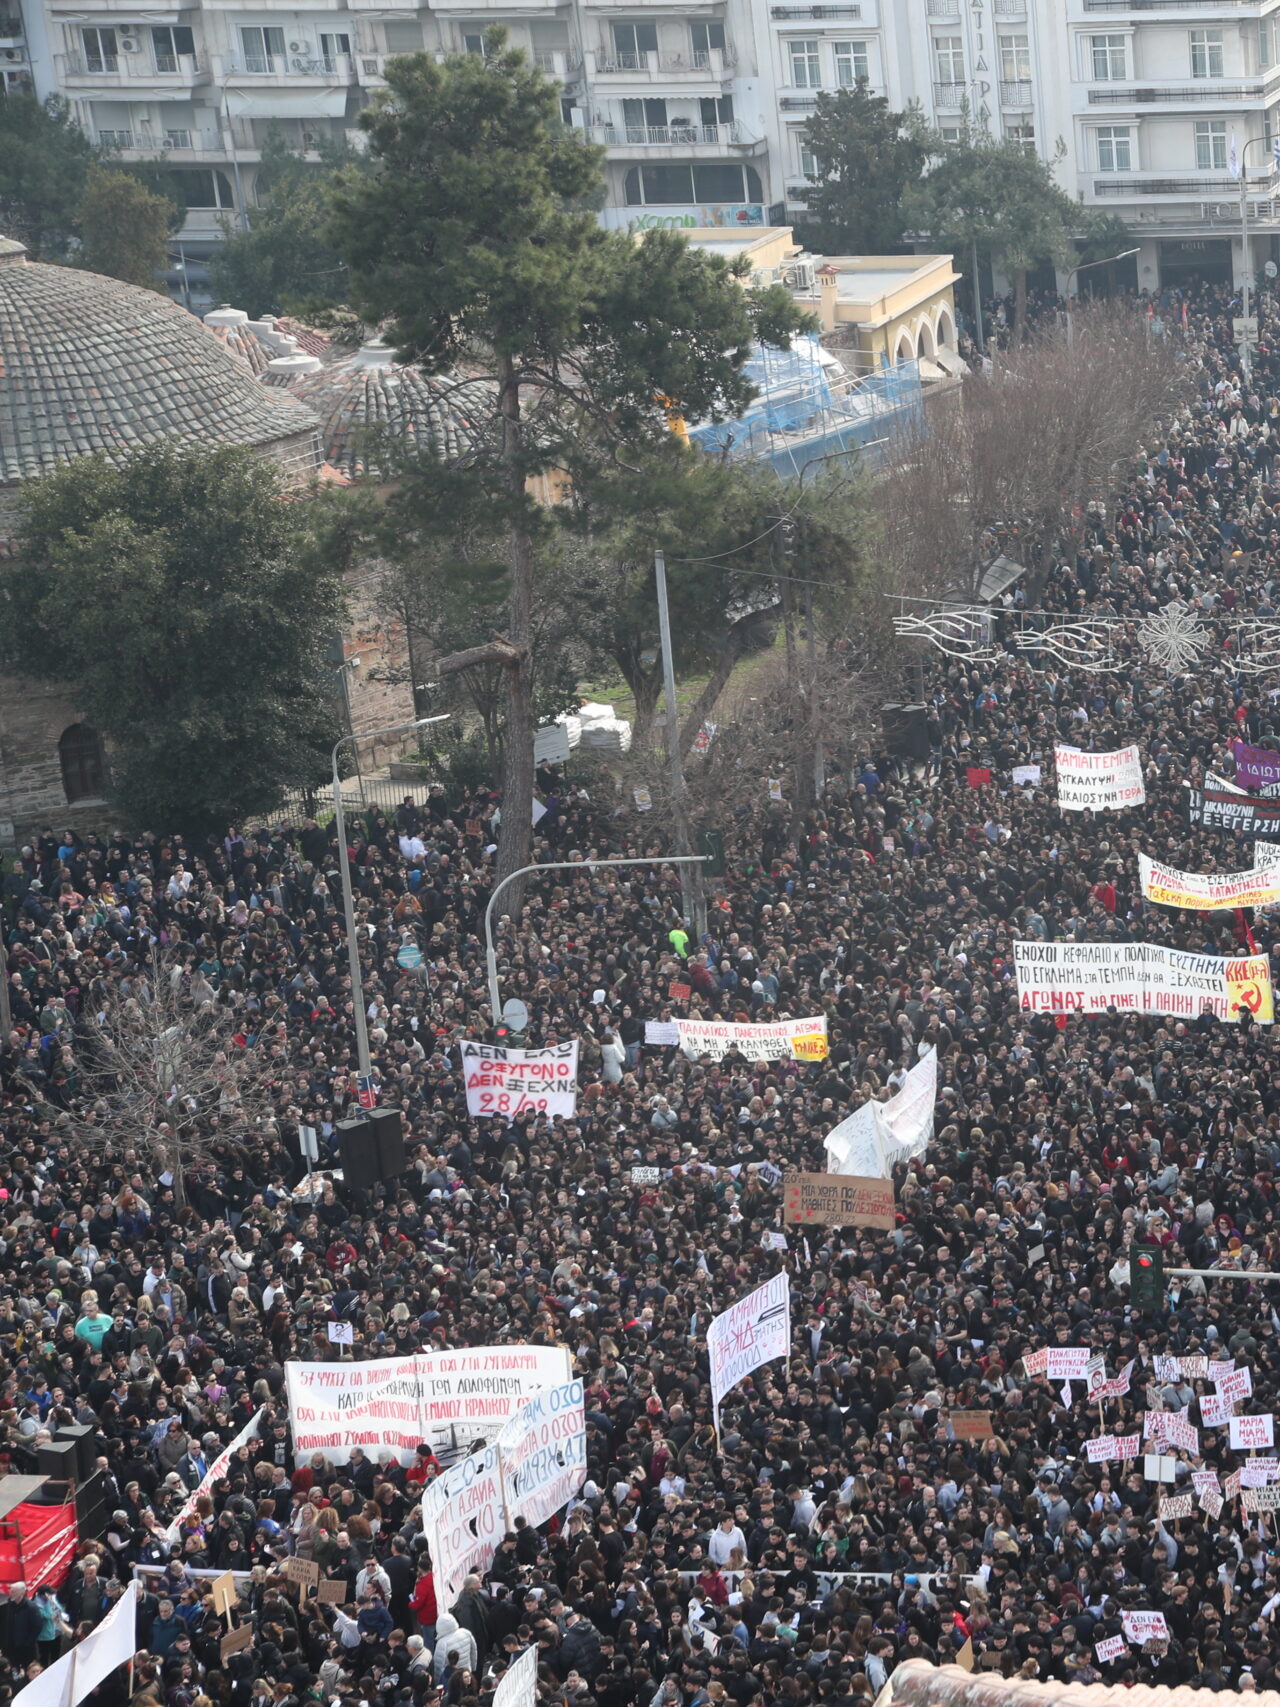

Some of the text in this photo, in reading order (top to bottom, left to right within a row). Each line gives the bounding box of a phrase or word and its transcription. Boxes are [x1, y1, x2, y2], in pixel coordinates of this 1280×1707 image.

[1058, 789, 1118, 804] ΔΙΚΑΙΟΣΥΝΗ
[1203, 801, 1255, 818] ΔΙΚΑΙΟΣΥΝΗ
[1203, 812, 1280, 833] ΕΞΕΓΕΡΣΗ
[1209, 873, 1271, 898] ΚΑΤΑΚΤΗΣΕΙΣ
[1014, 944, 1057, 963] ΕΝΟΧΟΙ
[1064, 946, 1111, 963] ΚΕΦΑΛΑΙΟ
[1169, 952, 1225, 976] ΣΥΣΤΗΜΑ
[1018, 965, 1031, 984] ΤΟ
[1033, 966, 1082, 984] ΕΓΚΛΗΜΑ
[1084, 973, 1098, 984] ΣΤΑ
[1098, 965, 1136, 984] ΤΕΜΠΗ
[1153, 973, 1165, 983] ΘΑ
[1170, 970, 1224, 993] ΞΕΧΑΣΤΕΙ
[1021, 991, 1194, 1014] ΑΓΩΝΑΣ ΝΑ ΓΙΝΕΙ Η ΛΑΙΚΗ
[463, 1042, 508, 1060] ΔΕΝ
[687, 1036, 699, 1047] ΝΑ
[703, 1037, 719, 1049] ΜΗ
[480, 1060, 570, 1080] ΟΞΥΓΟΝΟ
[467, 1073, 504, 1089] ΔΕΝ
[801, 1185, 816, 1197] ΜΙΑ
[840, 1186, 857, 1200] ΠΟΥ
[801, 1198, 838, 1213] ΜΑΘΗΤΕΣ
[840, 1199, 856, 1214] ΠΟΥ
[349, 1370, 364, 1386] ΘΑ
[440, 1358, 457, 1373] ΟΧΙ
[484, 1355, 538, 1371] ΣΥΓΚΑΛΥΨΗ
[429, 1379, 452, 1397] ΤΩΝ
[456, 1376, 522, 1396] ΔΟΛΟΦΟΝΩΝ
[296, 1405, 317, 1423] ΟΧΙ
[464, 1396, 512, 1417] ΚΡΑΤΙΚΟΣ
[1239, 1417, 1264, 1428] ΜΑΡΙΑ
[1238, 1427, 1266, 1437] ΜΙΑΡΗ
[1253, 1437, 1270, 1446] ΕΤΩΝ
[1130, 1616, 1146, 1624] ΔΕΝ
[1096, 1639, 1119, 1651] ΗΤΑΝ
